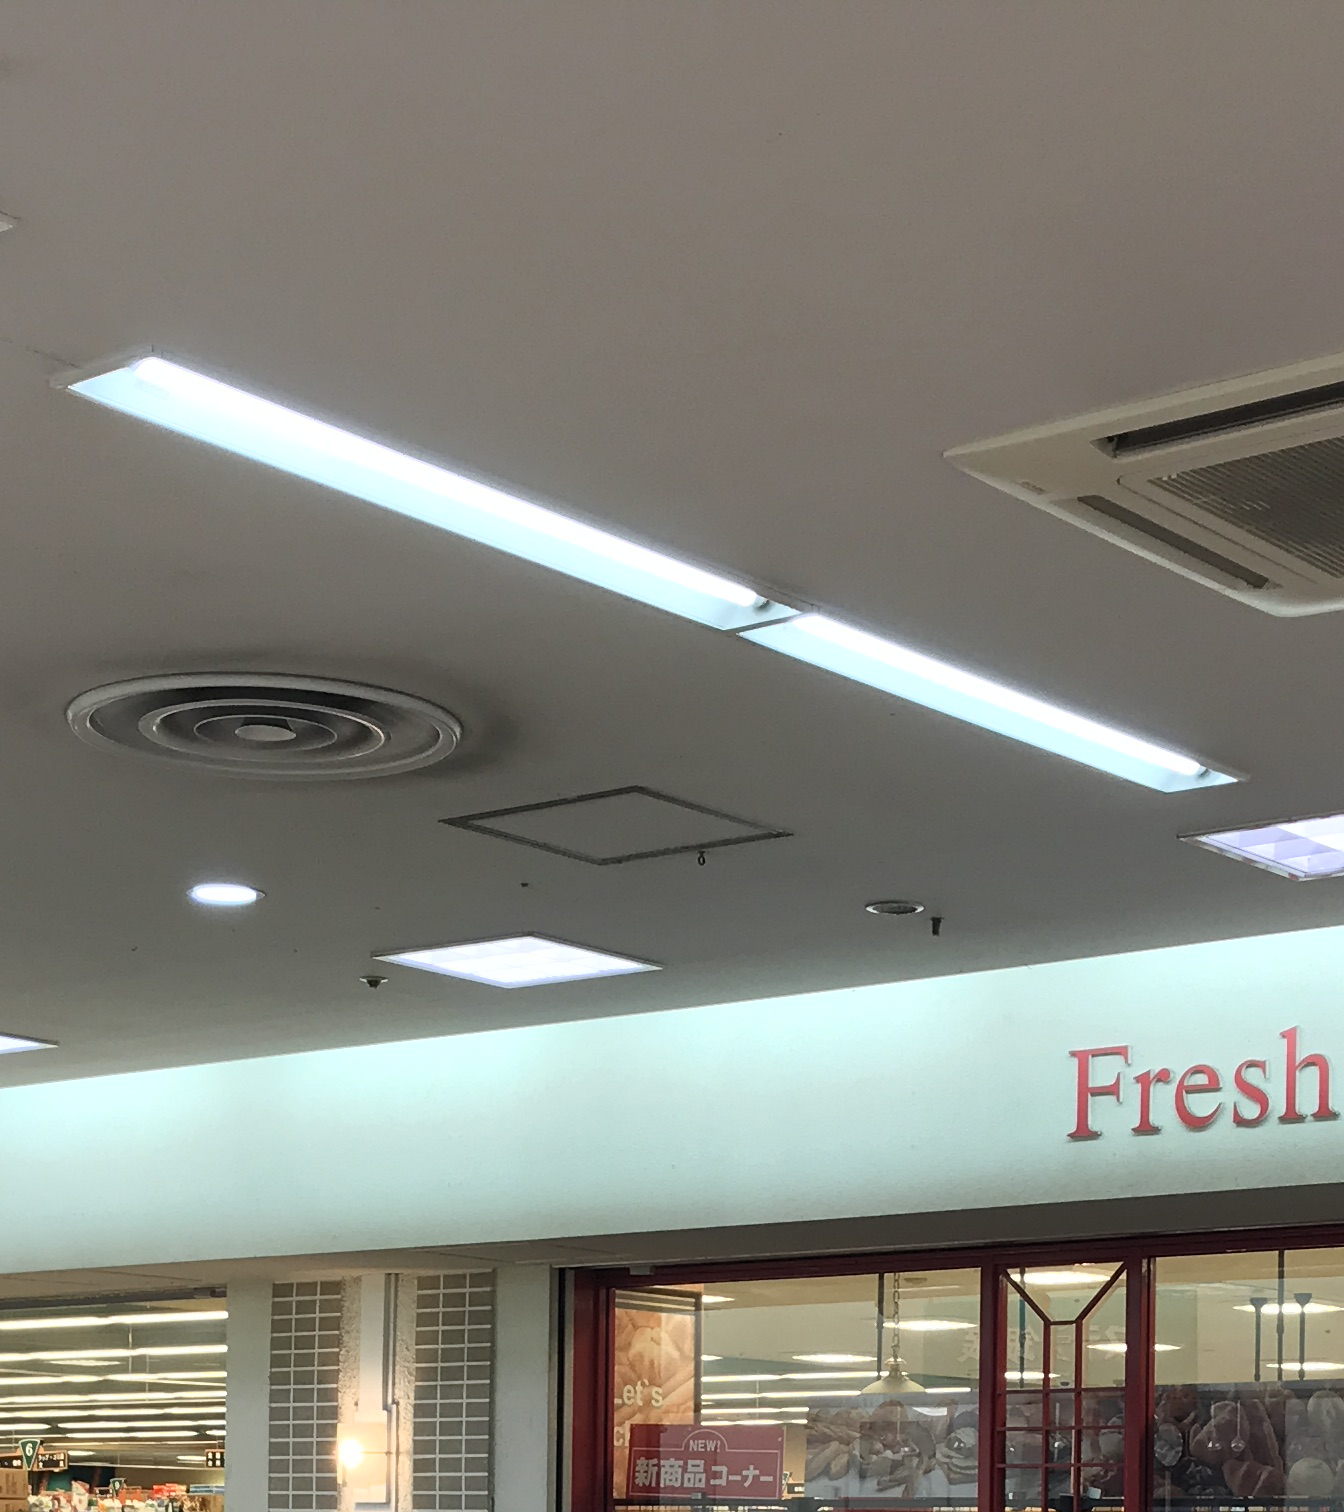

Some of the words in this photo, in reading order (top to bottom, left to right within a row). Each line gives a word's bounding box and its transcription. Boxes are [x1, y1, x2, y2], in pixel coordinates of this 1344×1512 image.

[1067, 1028, 1338, 1139] Fresh
[614, 1379, 663, 1407] et's
[25, 1443, 33, 1456] 6
[689, 1440, 721, 1452] NEW!
